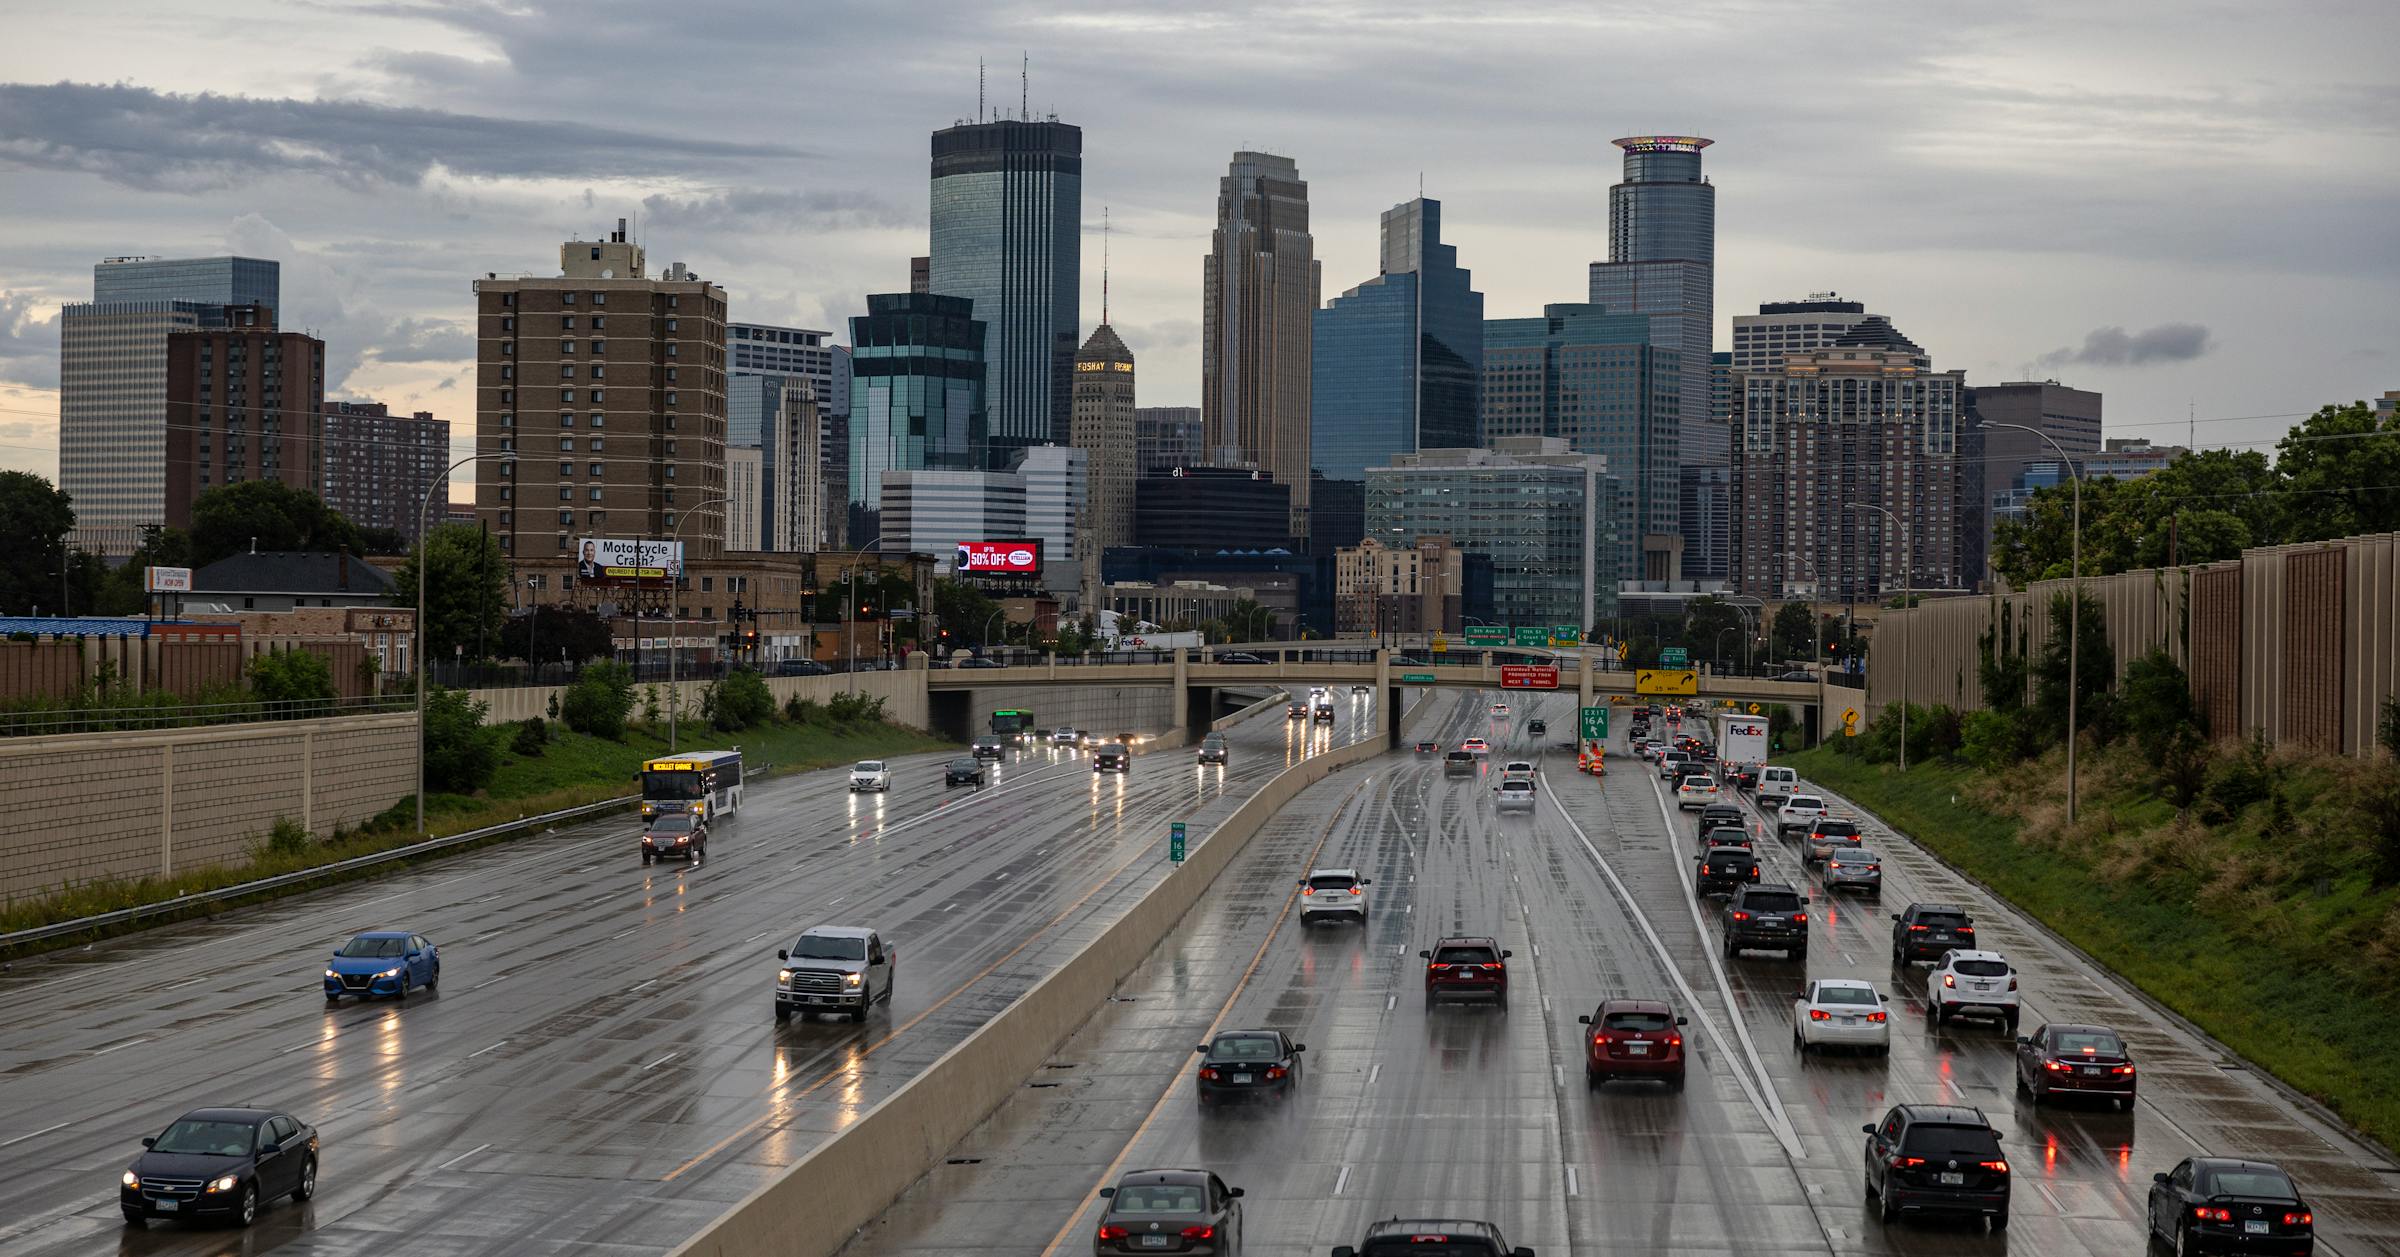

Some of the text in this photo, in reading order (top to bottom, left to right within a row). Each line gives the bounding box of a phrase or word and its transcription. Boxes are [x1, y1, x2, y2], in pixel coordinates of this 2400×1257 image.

[1077, 361, 1133, 372] FOSHAY FOSHAY
[603, 541, 668, 557] Motorcycle
[971, 552, 1006, 565] 50% OFF
[1120, 637, 1145, 646] FedEx
[1730, 724, 1763, 736] FedEx
[653, 763, 692, 771] NICOLLET GARAGE
[1173, 841, 1182, 850] 16
